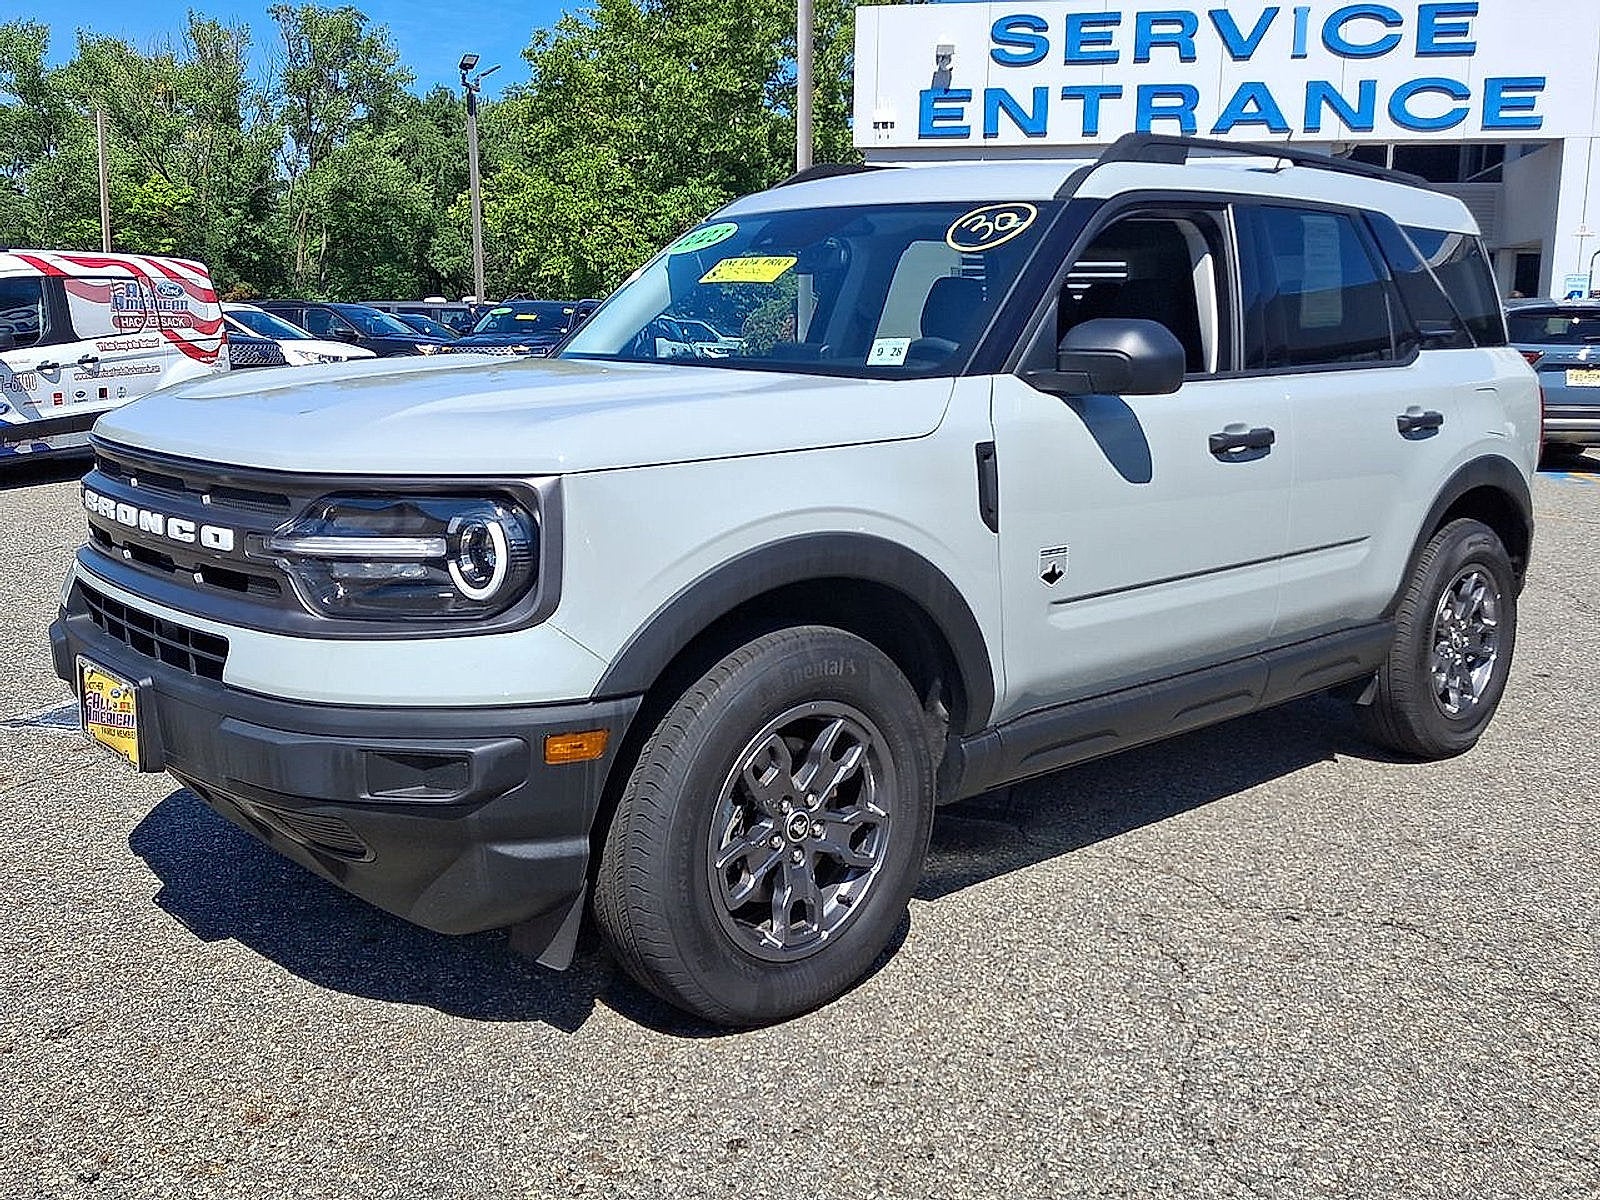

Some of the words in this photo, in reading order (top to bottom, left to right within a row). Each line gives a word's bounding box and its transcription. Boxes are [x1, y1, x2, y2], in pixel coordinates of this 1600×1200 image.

[990, 2, 1479, 67] SERVICE
[918, 77, 1546, 139] ENTRANCE
[762, 257, 792, 267] PRICE
[120, 316, 187, 329] HACKENSACK
[876, 347, 884, 357] 9
[84, 488, 234, 552] BRONCO
